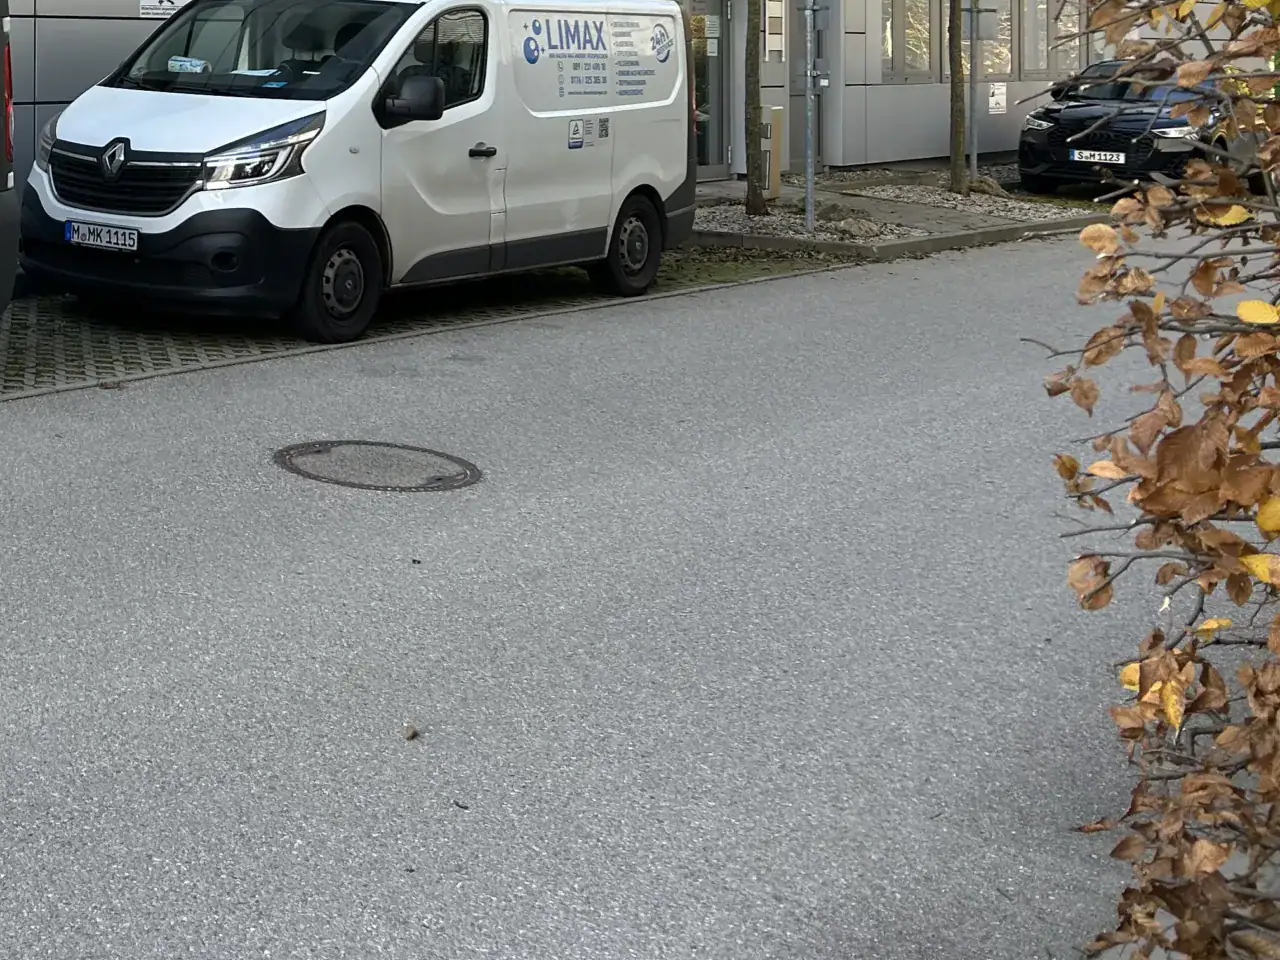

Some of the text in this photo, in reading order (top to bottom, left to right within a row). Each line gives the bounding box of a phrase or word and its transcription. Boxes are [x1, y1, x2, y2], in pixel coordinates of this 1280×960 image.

[545, 19, 607, 51] LIMAX
[1077, 151, 1084, 160] S
[1097, 153, 1120, 162] 1123
[72, 224, 80, 240] M
[88, 226, 103, 243] MK
[106, 229, 136, 248] 1115
